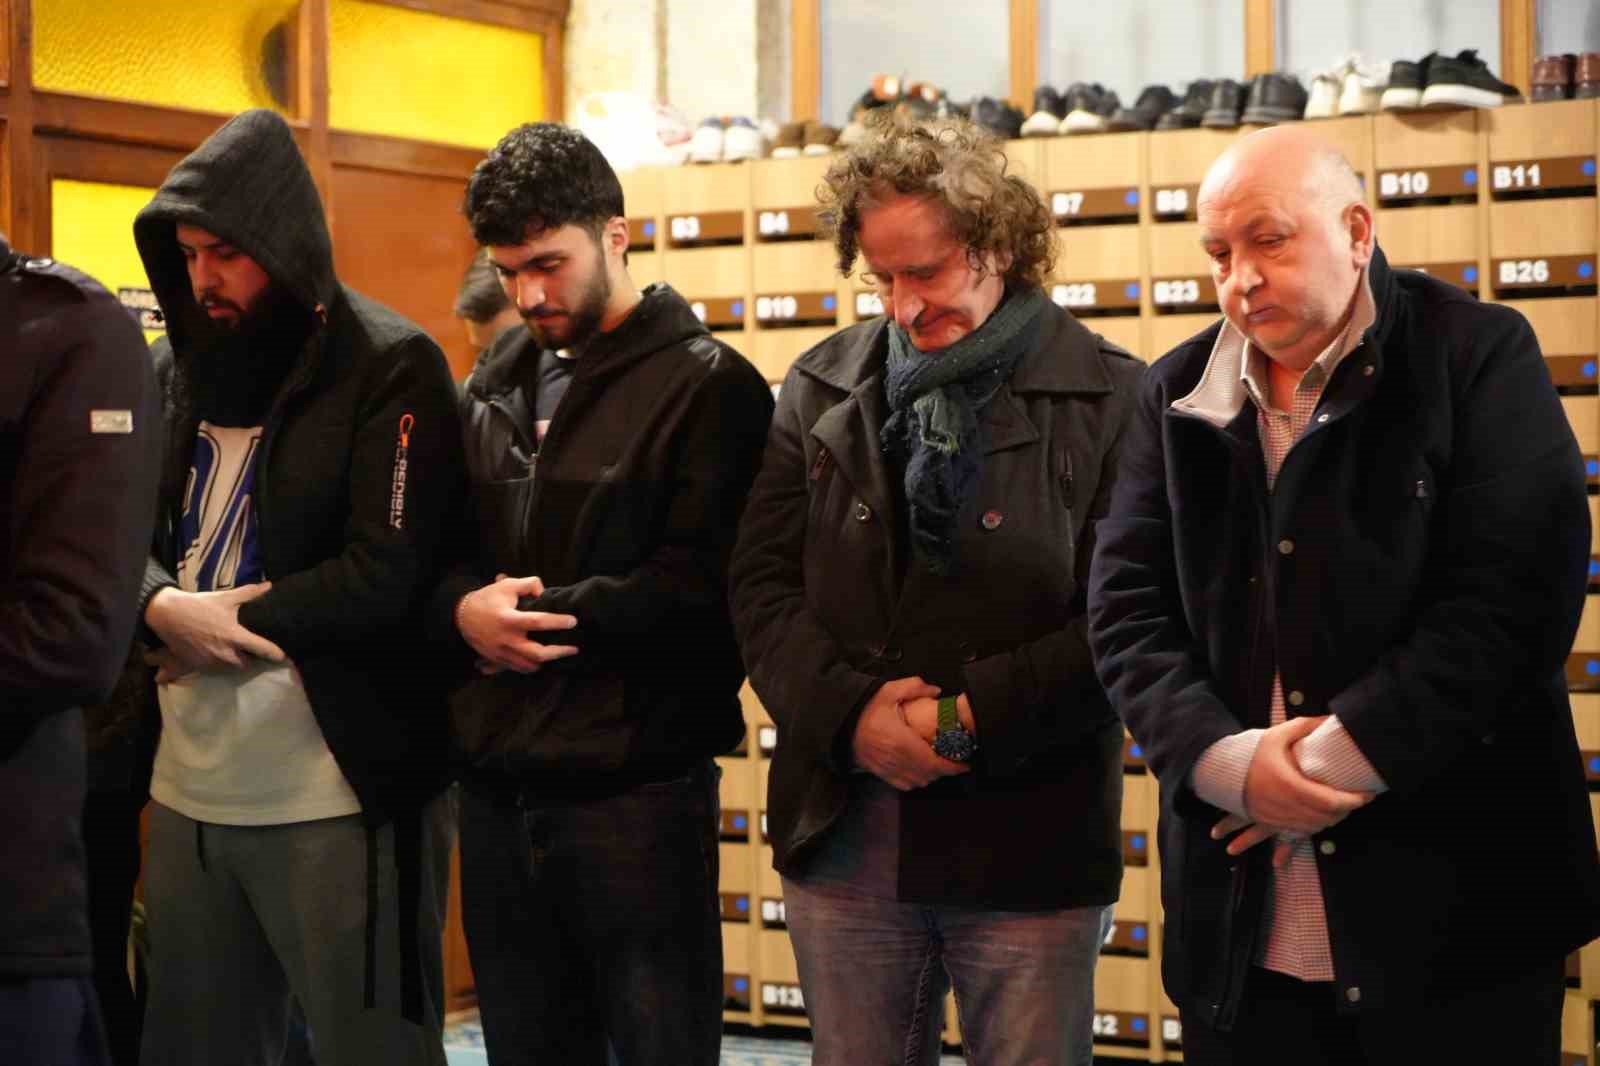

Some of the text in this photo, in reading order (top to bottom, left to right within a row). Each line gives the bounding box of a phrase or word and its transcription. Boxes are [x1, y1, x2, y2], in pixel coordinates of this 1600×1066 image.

[1380, 172, 1429, 196] B10
[1494, 165, 1540, 189] B11
[1052, 193, 1084, 215] B7
[671, 217, 699, 239] B3
[759, 212, 788, 234] B4
[1500, 260, 1549, 283] B26
[1052, 284, 1095, 307] B22
[1154, 281, 1198, 304] B23
[856, 293, 884, 315] B2
[762, 900, 786, 921] B1
[762, 985, 805, 1008] B13
[1092, 1014, 1118, 1036] 42
